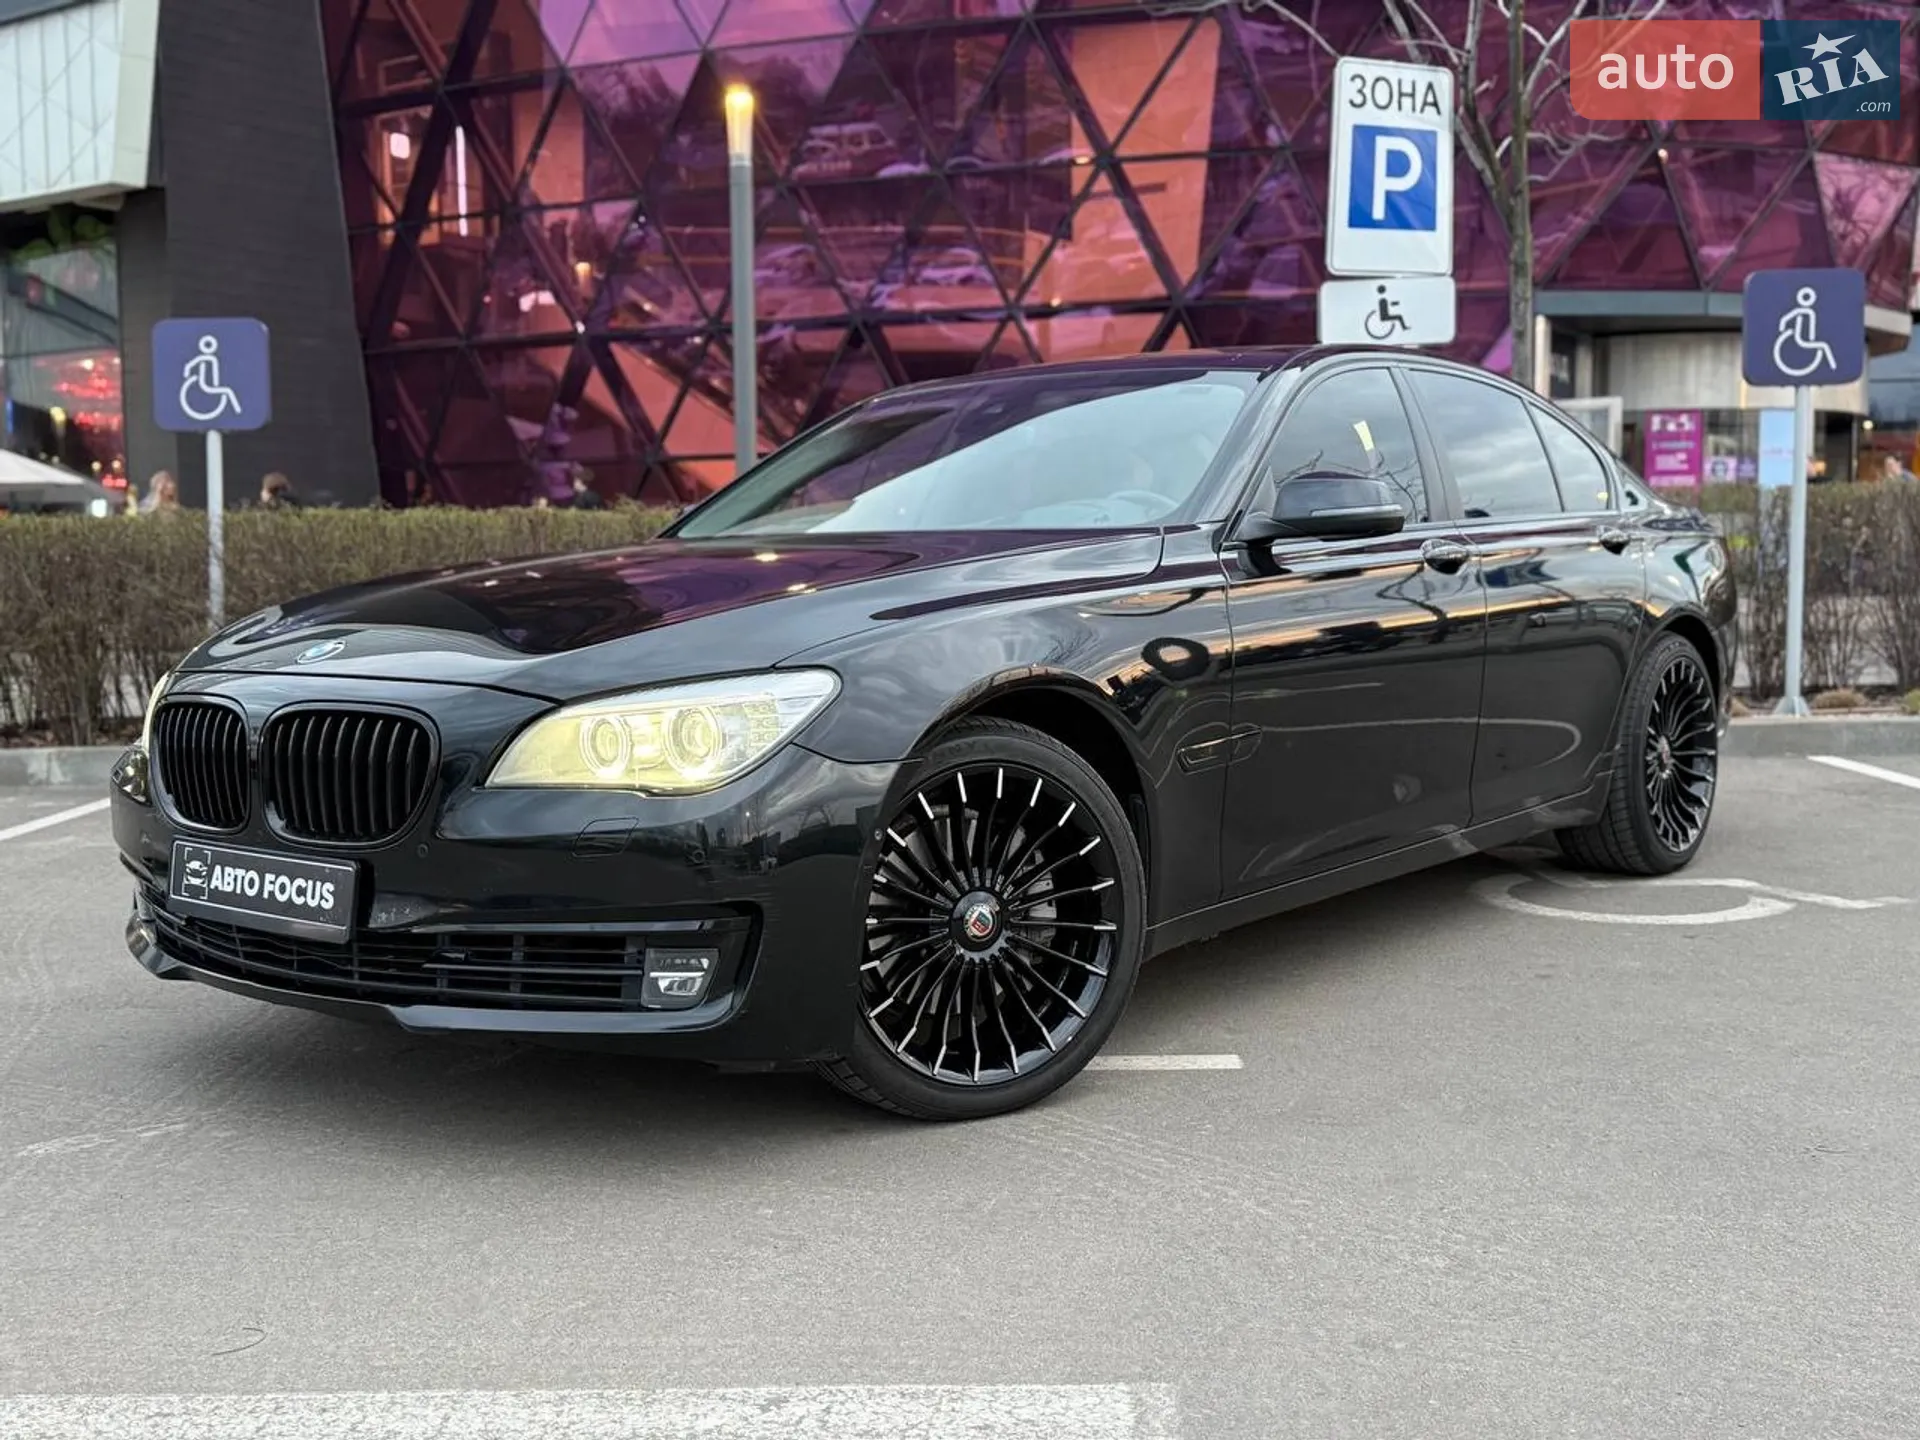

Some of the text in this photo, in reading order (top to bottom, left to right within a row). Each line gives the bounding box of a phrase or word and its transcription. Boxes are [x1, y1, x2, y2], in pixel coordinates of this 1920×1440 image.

[1348, 74, 1441, 116] ЗОНА
[1371, 135, 1423, 221] P
[210, 864, 336, 910] АВТО FOCUS
